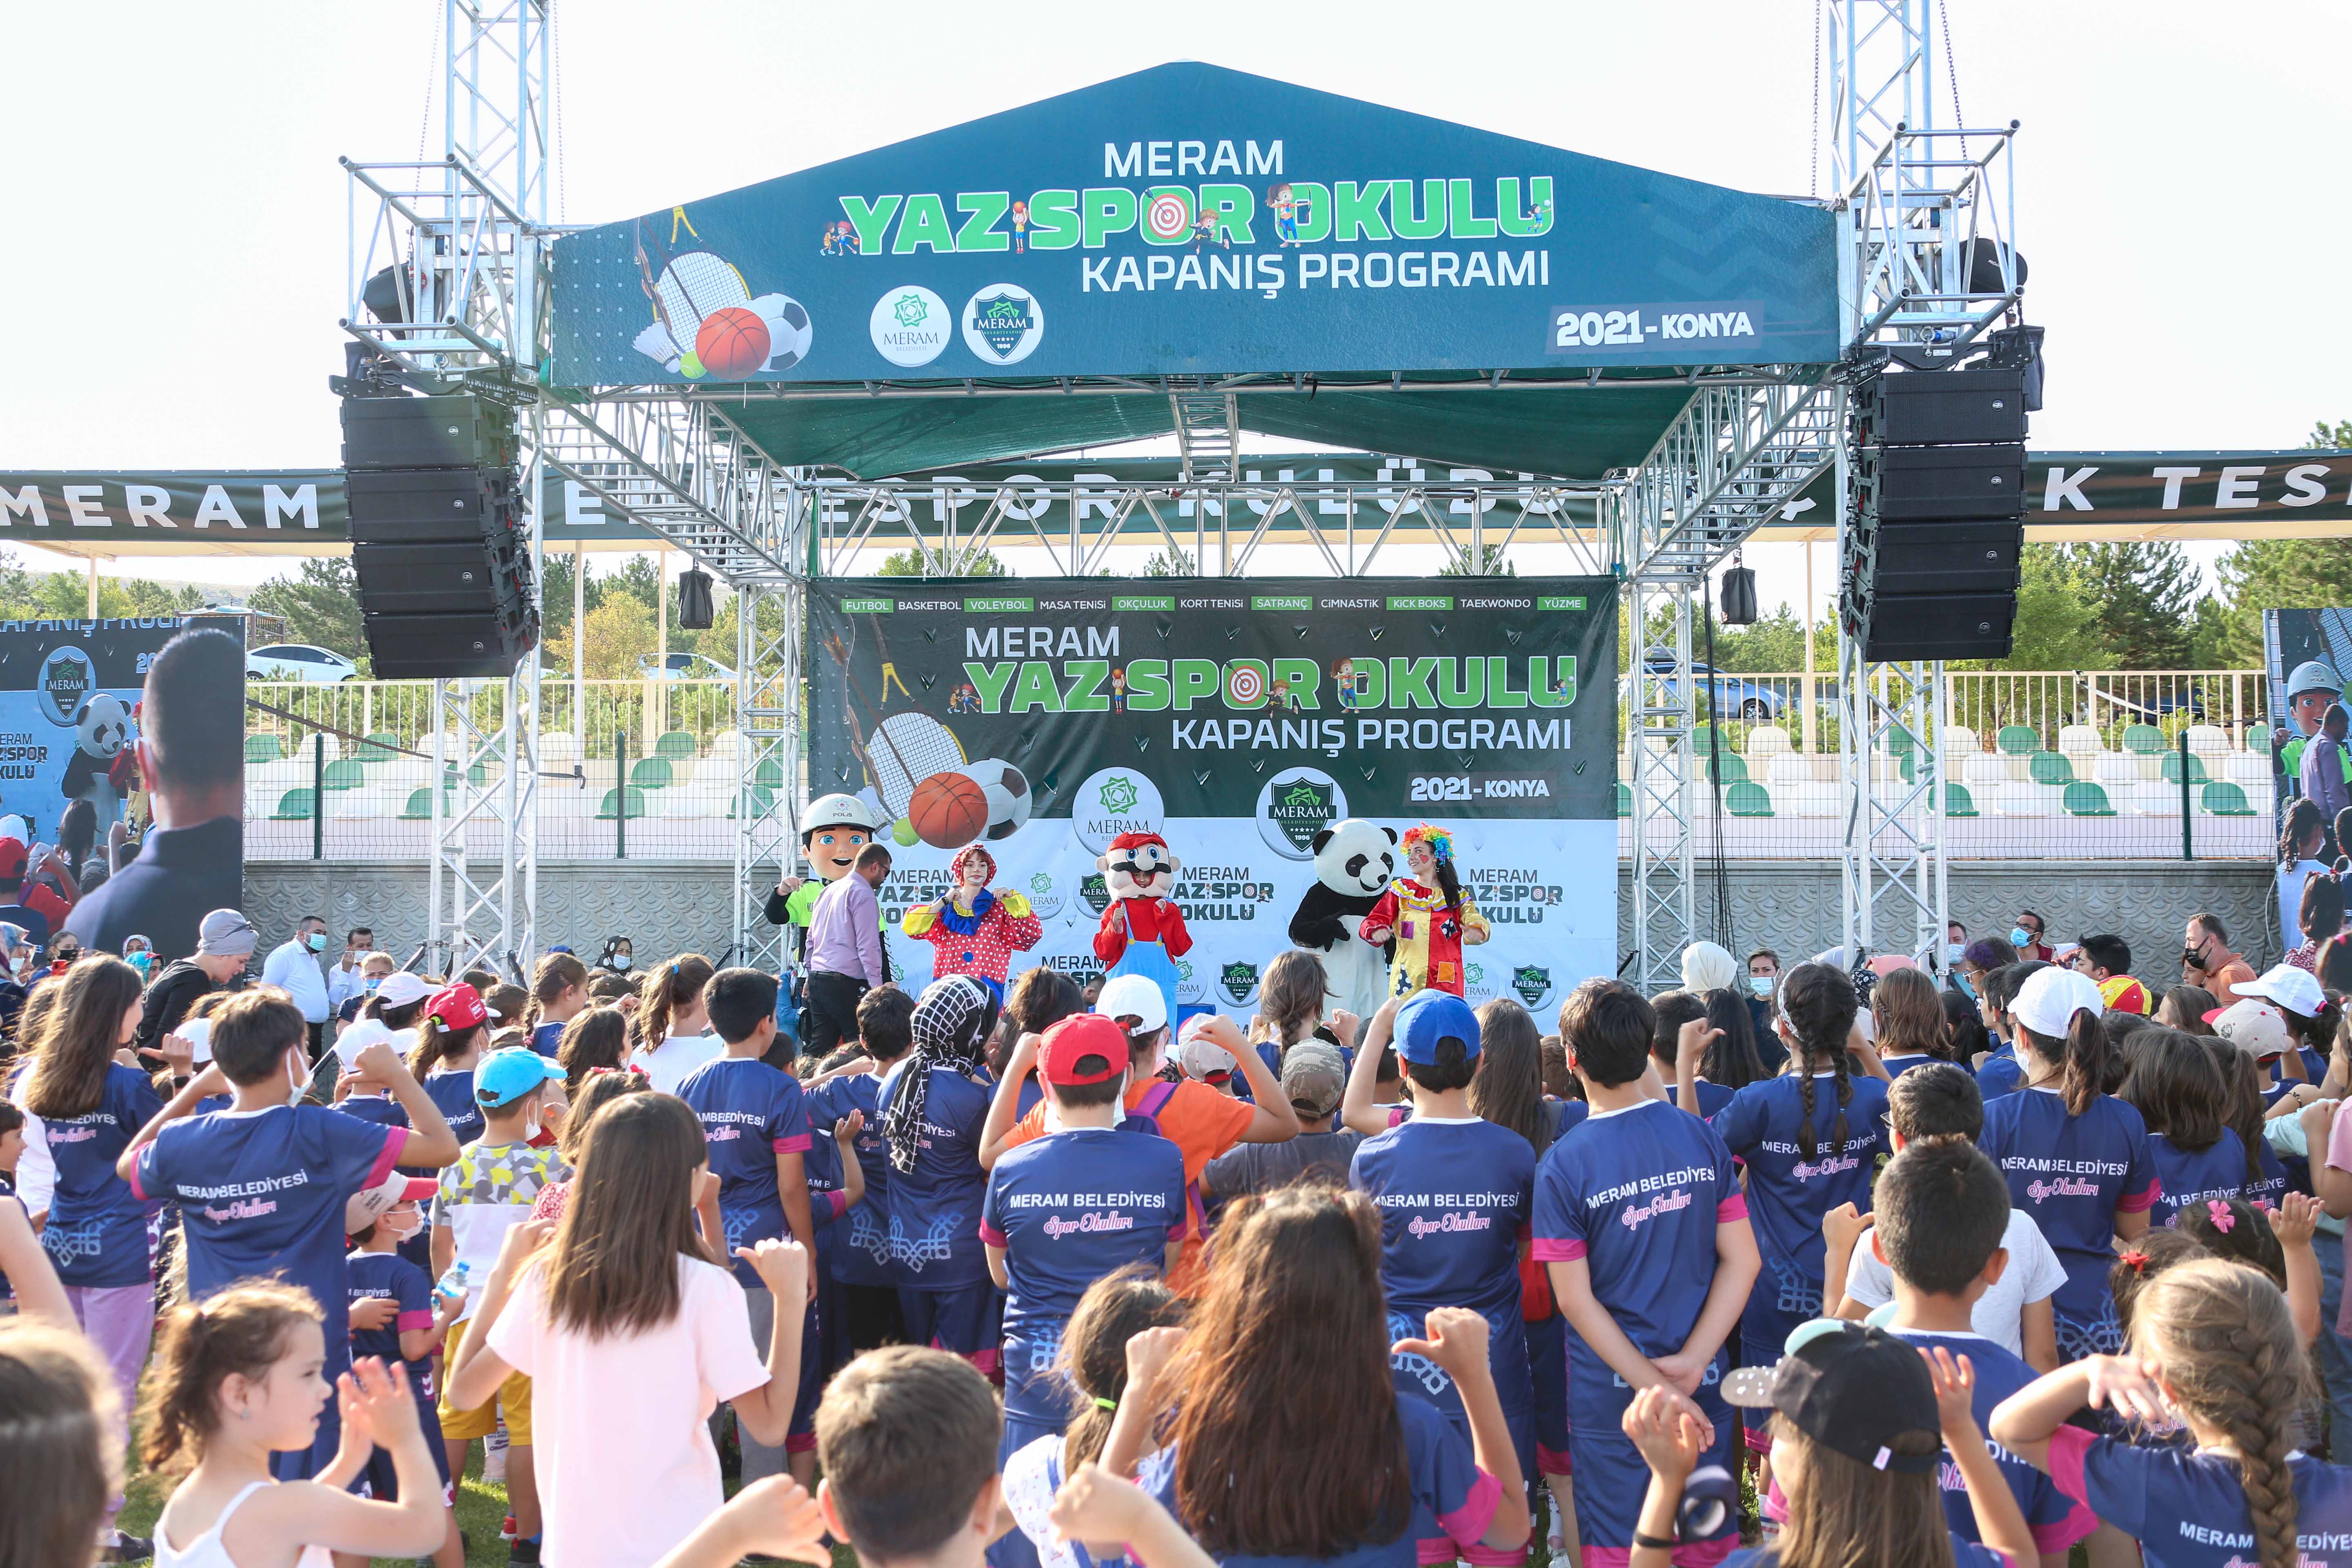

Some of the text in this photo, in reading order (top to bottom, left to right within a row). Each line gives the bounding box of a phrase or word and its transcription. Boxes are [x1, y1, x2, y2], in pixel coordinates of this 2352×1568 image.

[1105, 140, 1283, 177] MERAM
[838, 176, 1554, 256] YAZ SPOR OKULU
[1082, 250, 1549, 299] KAPANIŞ PROGRAMI
[977, 317, 1027, 330] MERAM
[883, 332, 939, 345] MERAM
[2152, 464, 2352, 510] TES
[0, 484, 319, 529] MERAM
[846, 601, 889, 610] FUTBOL
[898, 601, 962, 610] BASKETBOL
[970, 600, 1028, 610] VOLEYBOL
[1040, 600, 1071, 610] MASA
[1118, 599, 1167, 610] OKÇULUK
[1180, 599, 1209, 608] KORT
[1256, 599, 1307, 610] SATRANÇ
[1418, 599, 1446, 608] BOKS
[1460, 599, 1531, 608] TAEKWONDO
[1544, 598, 1581, 608] YÜZME
[966, 626, 1119, 657] MERAM
[48, 679, 84, 690] MERAM
[962, 656, 1577, 714] YAZ SPOR OKULU
[0, 733, 32, 745] ERAM
[1172, 719, 1571, 758] KAPANIŞ PROGRAMI
[1274, 806, 1330, 817] MERAM
[1087, 819, 1149, 834] MERAM
[891, 869, 956, 884] MERAM
[1183, 867, 1249, 881] MERAM
[1470, 869, 1538, 884] MERAM
[1212, 883, 1274, 899] SPOR
[1464, 884, 1564, 902] AZ SPOR
[1178, 904, 1255, 920] OKULU
[1475, 906, 1544, 924] KULU
[1176, 984, 1200, 993] ERAM
[1465, 987, 1490, 996] ERAM
[1762, 1131, 1876, 1155] MERA BEEDİYESİ
[1793, 1161, 1820, 1183] Spor
[2002, 1156, 2128, 1176] MERAM BELEDİYESİ
[219, 1169, 309, 1197] BELEDİYESİ
[1586, 1166, 1716, 1210] MERAM BELEDİYESİ
[2027, 1177, 2099, 1204] Spor Okulları
[1010, 1190, 1166, 1209] MERAM BELEDİYESİ
[1434, 1191, 1520, 1207] BELEDİYESİ
[1621, 1189, 1691, 1231] Spor Okulları
[1043, 1211, 1133, 1240] Spor Okulları
[1408, 1211, 1490, 1240] Spor Okulları
[2180, 1521, 2254, 1549] MERAM
